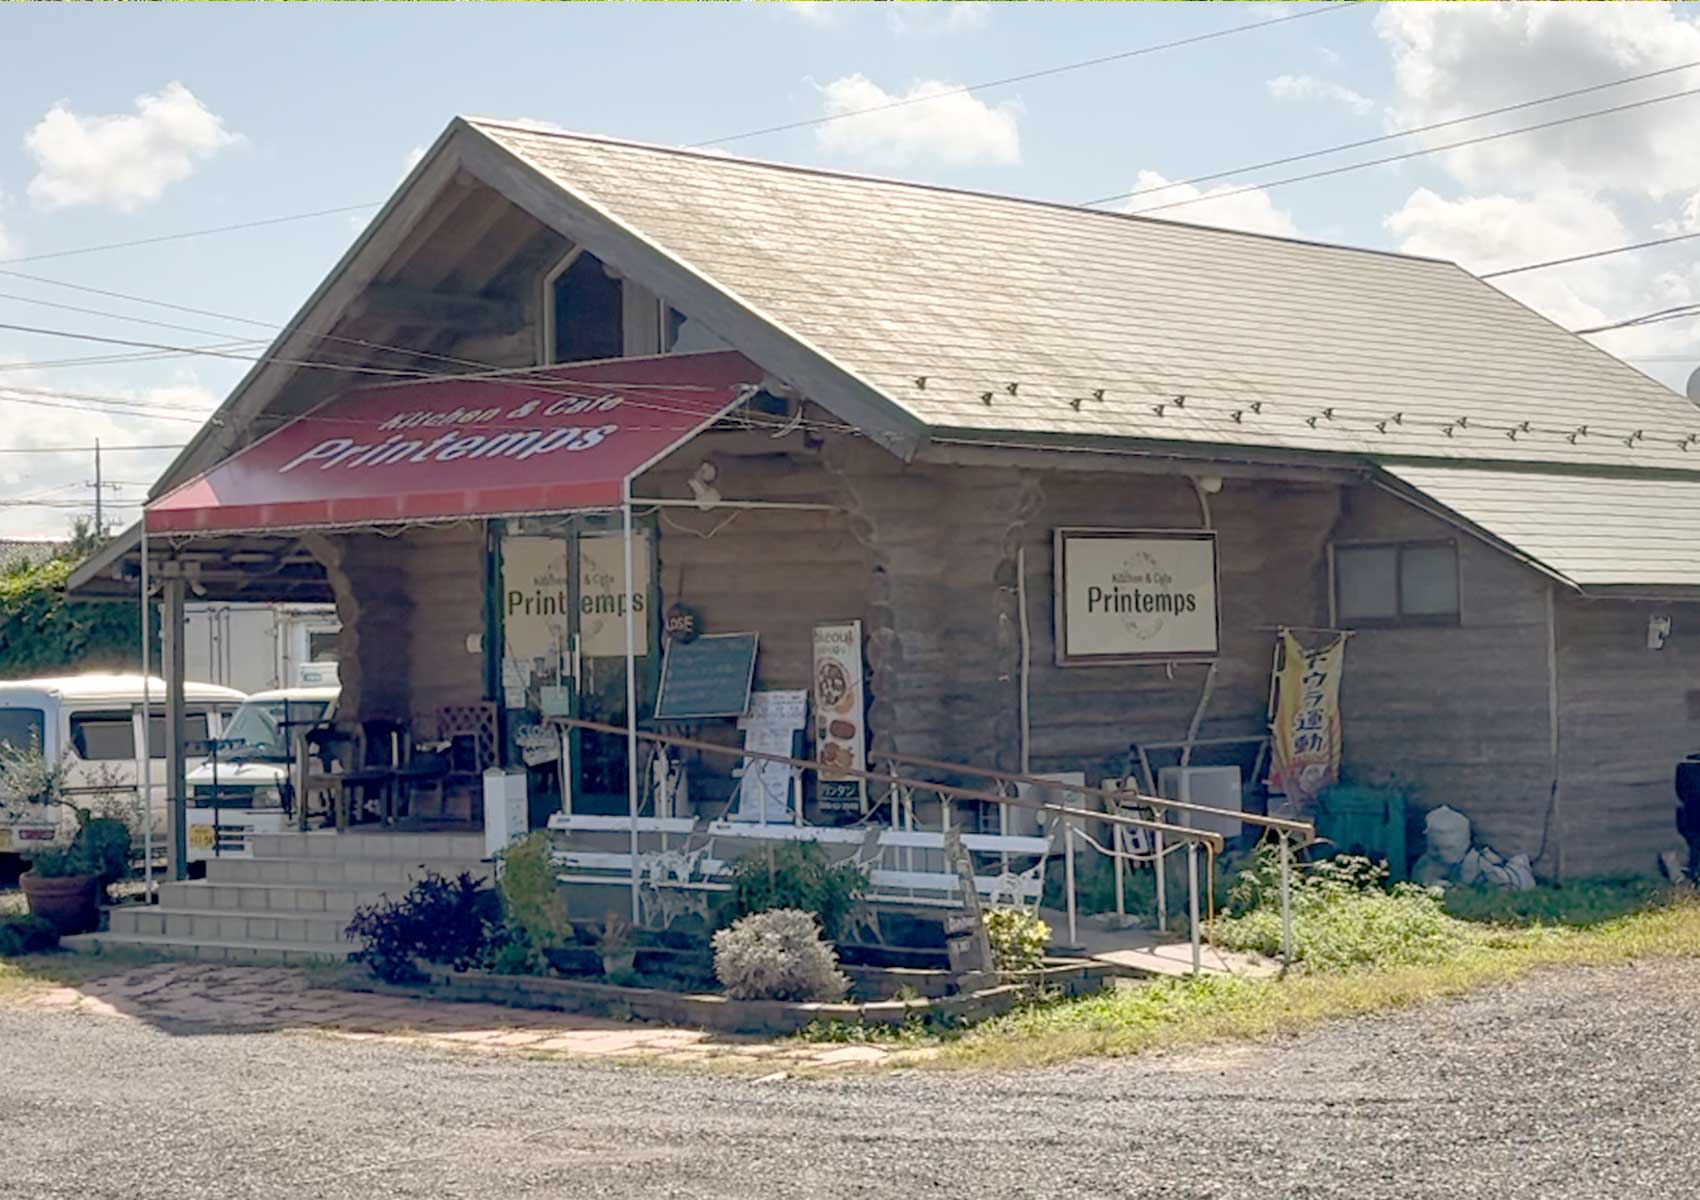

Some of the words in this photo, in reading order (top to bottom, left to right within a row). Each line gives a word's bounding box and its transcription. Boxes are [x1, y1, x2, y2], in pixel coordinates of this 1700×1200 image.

[377, 406, 501, 431] Kitchen
[506, 400, 541, 419] &
[279, 424, 619, 473] Printemps
[1087, 586, 1196, 616] Printemps
